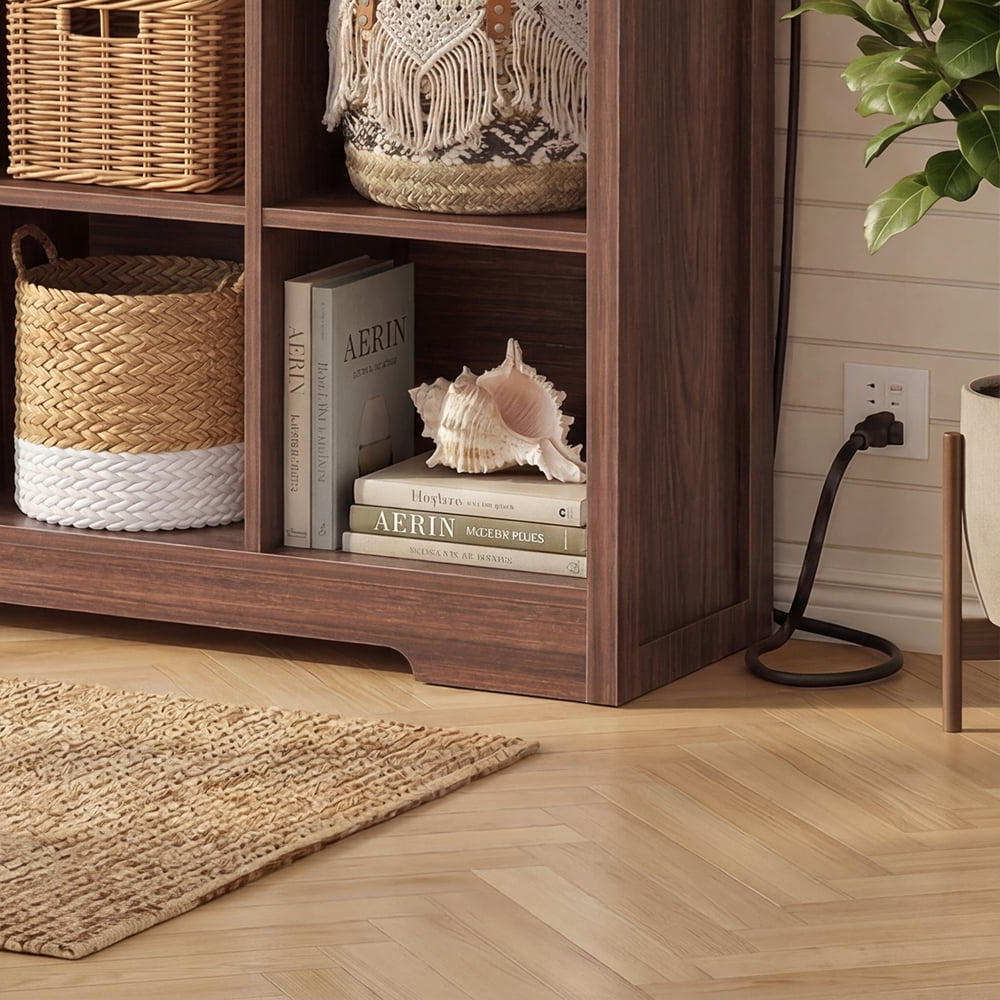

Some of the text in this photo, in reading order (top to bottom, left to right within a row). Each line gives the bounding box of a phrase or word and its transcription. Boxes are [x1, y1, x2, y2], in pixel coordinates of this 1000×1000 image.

[288, 325, 305, 395] AERIN
[343, 315, 407, 363] AERIN
[373, 511, 456, 538] AERIN
